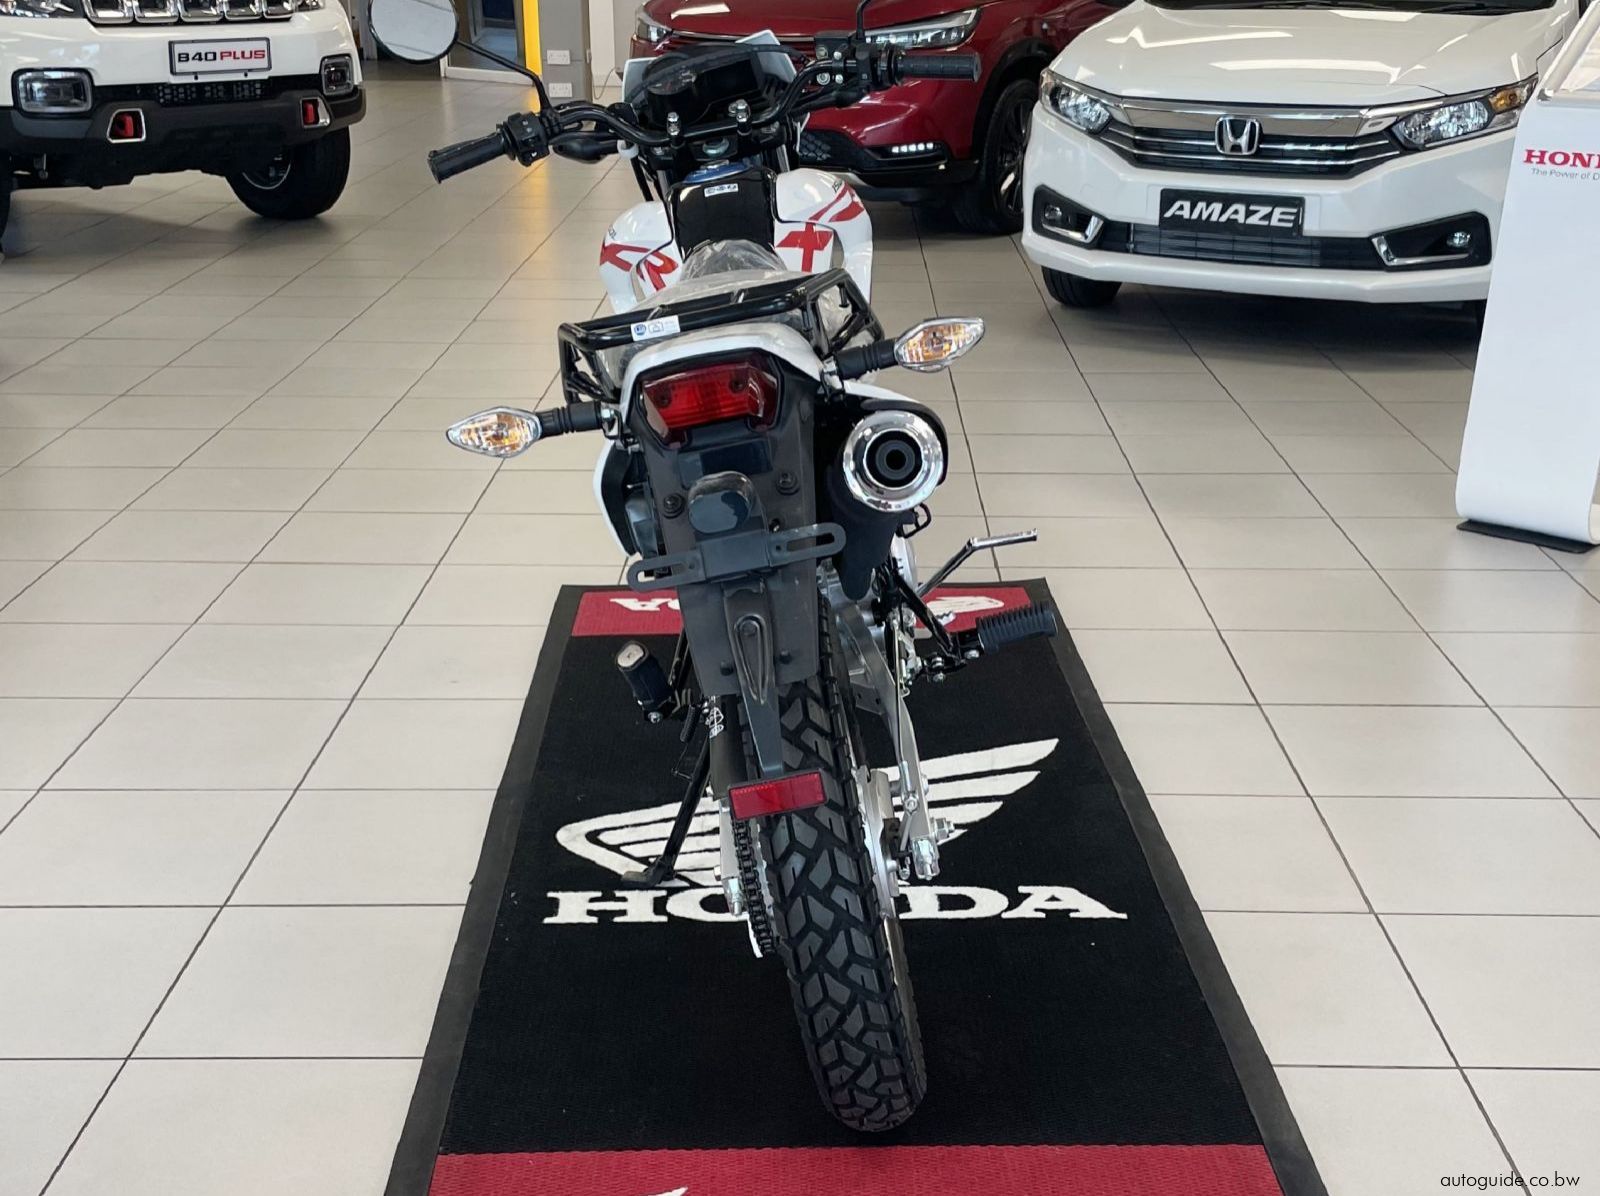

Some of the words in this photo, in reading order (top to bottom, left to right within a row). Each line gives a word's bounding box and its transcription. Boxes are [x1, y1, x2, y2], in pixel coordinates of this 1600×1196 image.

[219, 49, 266, 61] PLUS
[1523, 149, 1600, 169] HON
[1531, 167, 1548, 176] The
[1549, 168, 1579, 179] Power
[1580, 172, 1591, 180] of
[1163, 199, 1298, 228] AMAZE
[543, 885, 1128, 924] HODA
